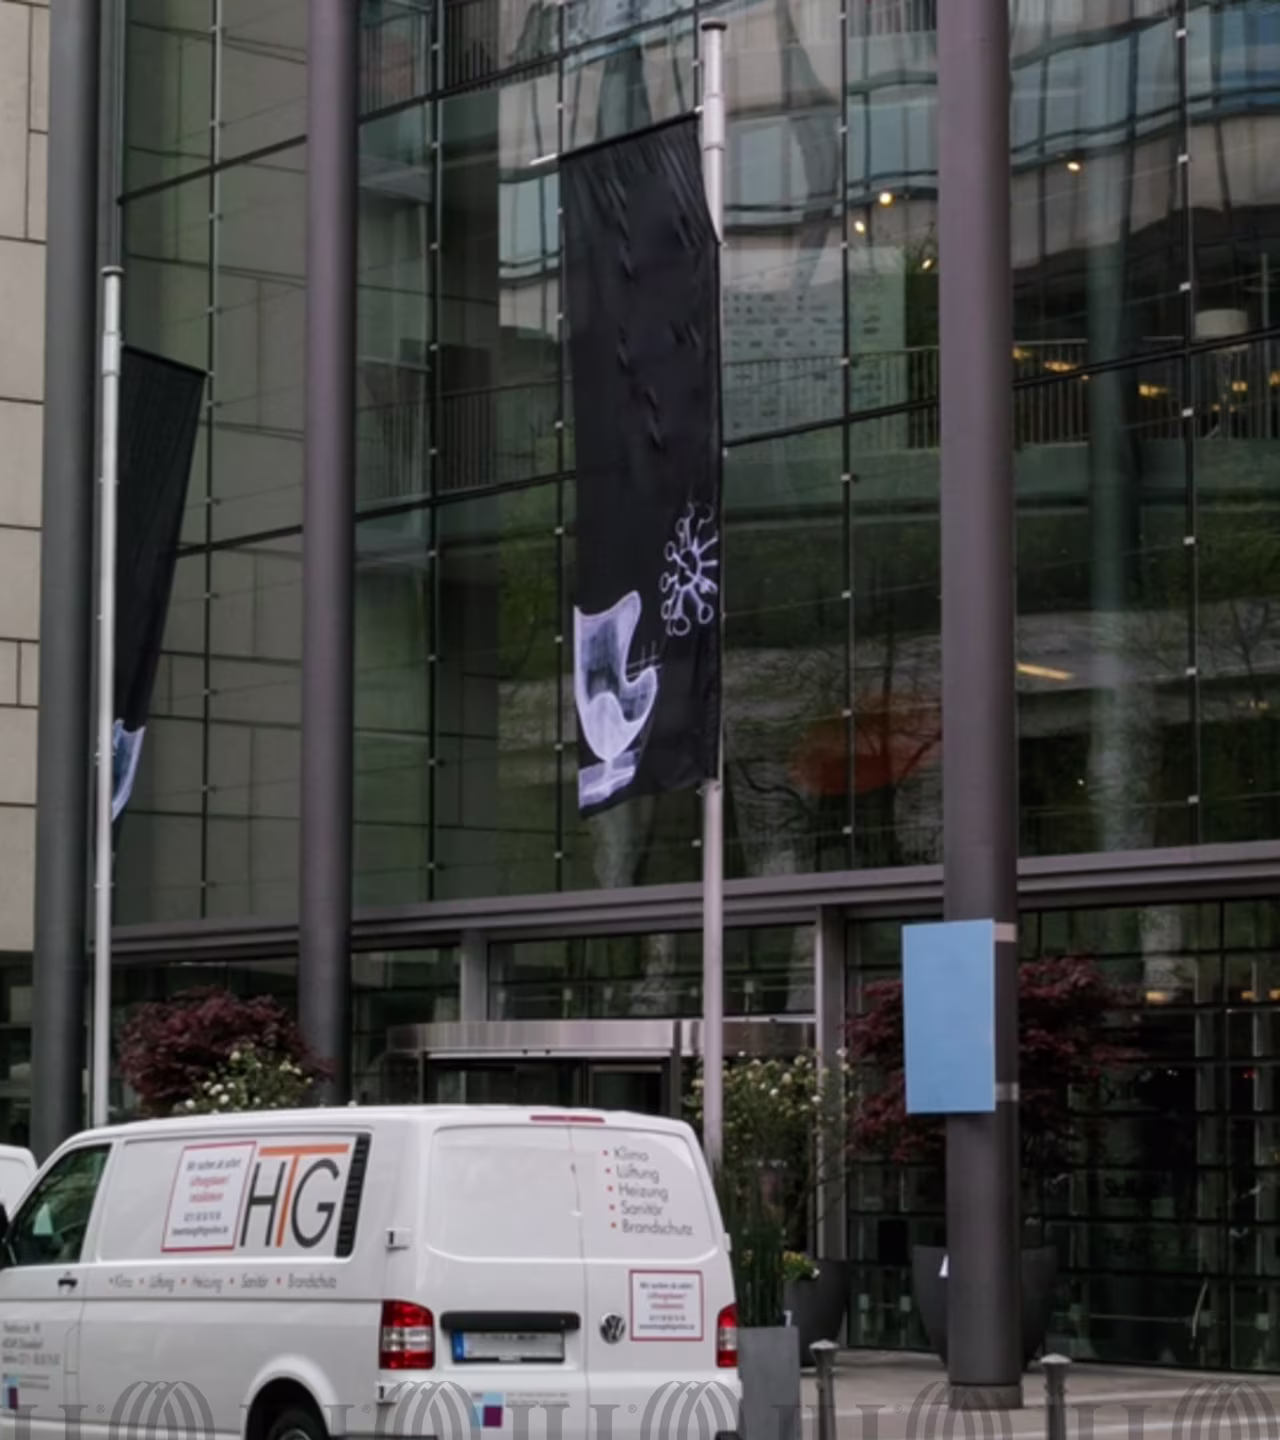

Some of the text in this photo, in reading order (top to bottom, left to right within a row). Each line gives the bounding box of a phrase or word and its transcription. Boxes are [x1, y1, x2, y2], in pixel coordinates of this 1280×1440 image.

[613, 1146, 650, 1161] Klima
[616, 1163, 660, 1184] Lüftung
[239, 1143, 350, 1249] HTG
[618, 1182, 669, 1203] Heizung
[622, 1218, 694, 1236] Brandschutz
